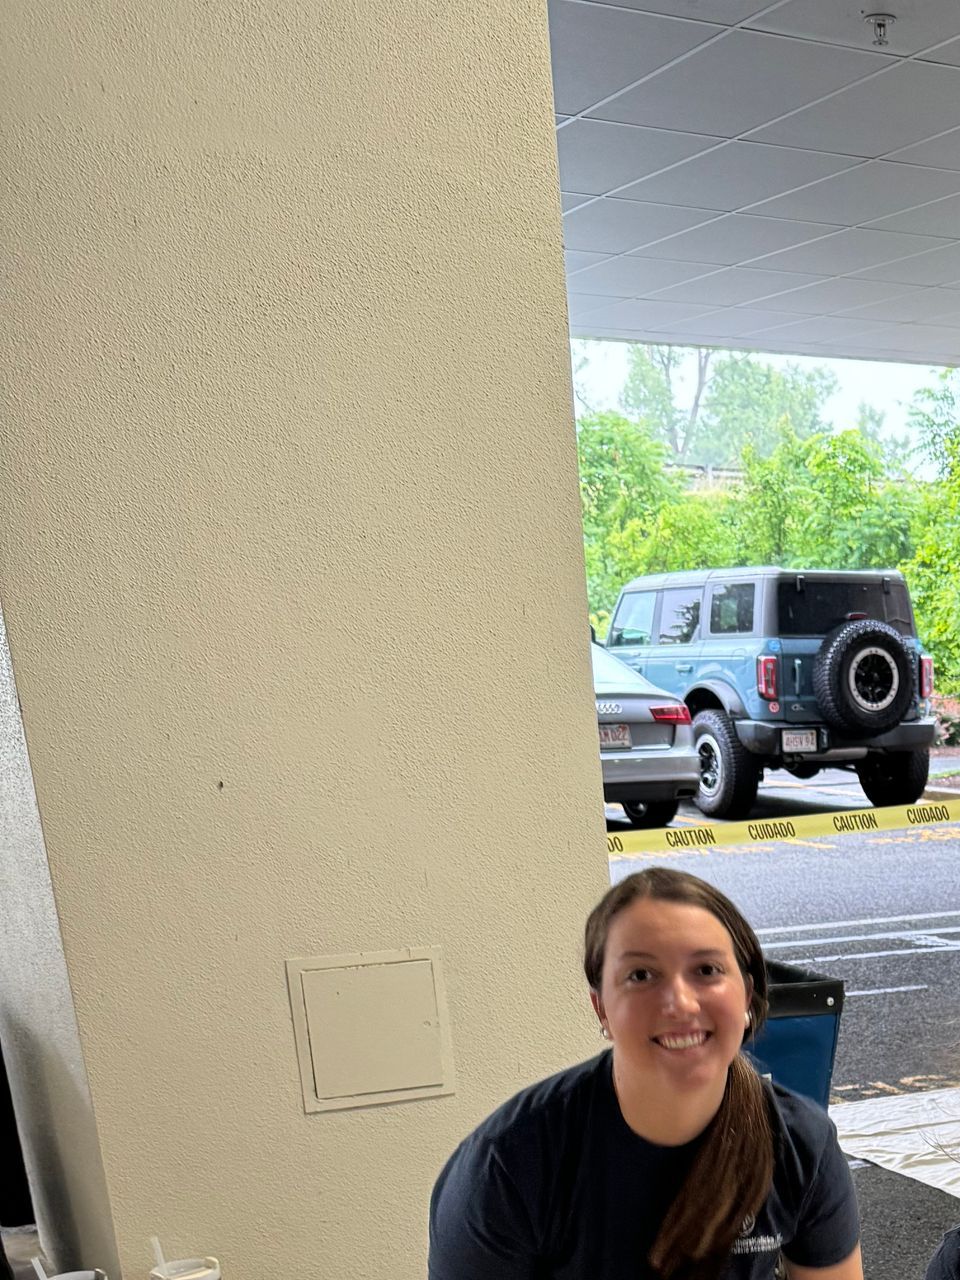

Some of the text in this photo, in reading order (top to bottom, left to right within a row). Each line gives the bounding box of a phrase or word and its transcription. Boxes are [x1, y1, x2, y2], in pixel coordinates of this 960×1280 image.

[666, 828, 717, 848] CAUTION
[748, 821, 796, 841] CUIDADO
[833, 812, 879, 833] CAUTION
[906, 804, 950, 825] CUIDADO
